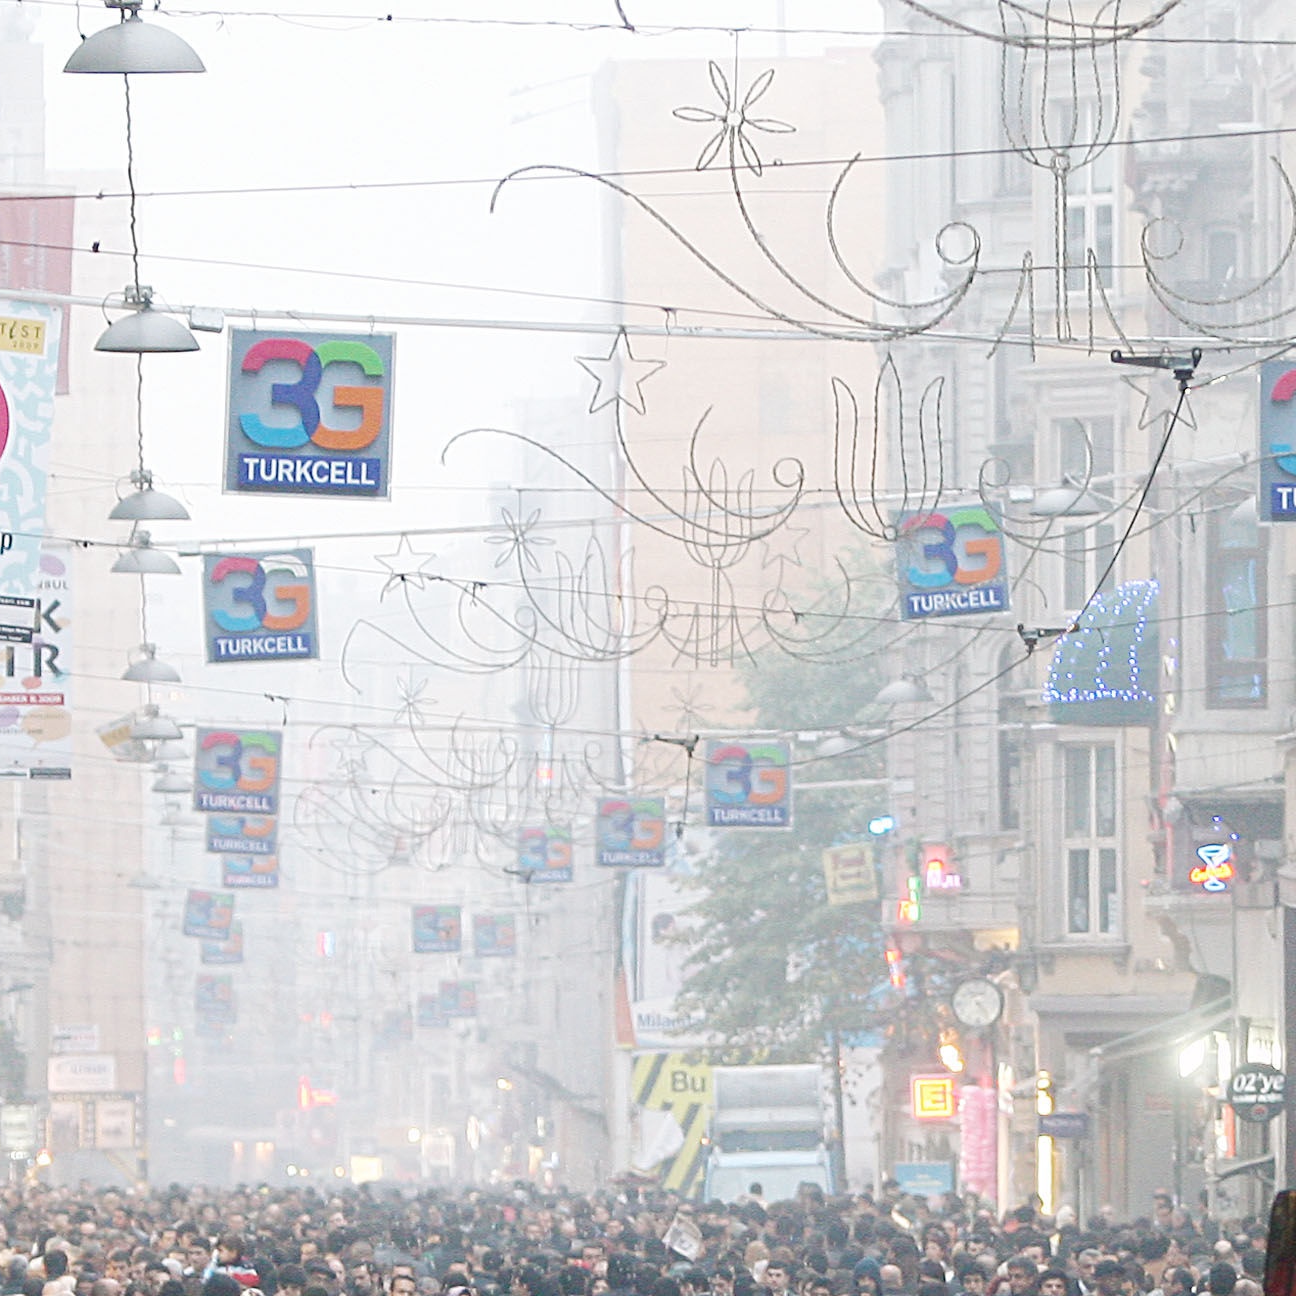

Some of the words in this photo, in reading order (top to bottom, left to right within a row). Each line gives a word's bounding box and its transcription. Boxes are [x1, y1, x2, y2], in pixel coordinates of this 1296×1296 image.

[239, 338, 384, 450] 3G
[243, 457, 375, 485] TURKCELL
[901, 508, 1001, 588] 3G
[210, 555, 310, 632] 3G
[909, 588, 1000, 614] TURKCELL
[216, 636, 308, 655] TURKCELL
[199, 732, 277, 791] 3G
[710, 746, 787, 804] 3G
[200, 793, 271, 811] TURKCELL
[713, 807, 782, 823] TURKCELL
[604, 851, 660, 865] TURKCELL
